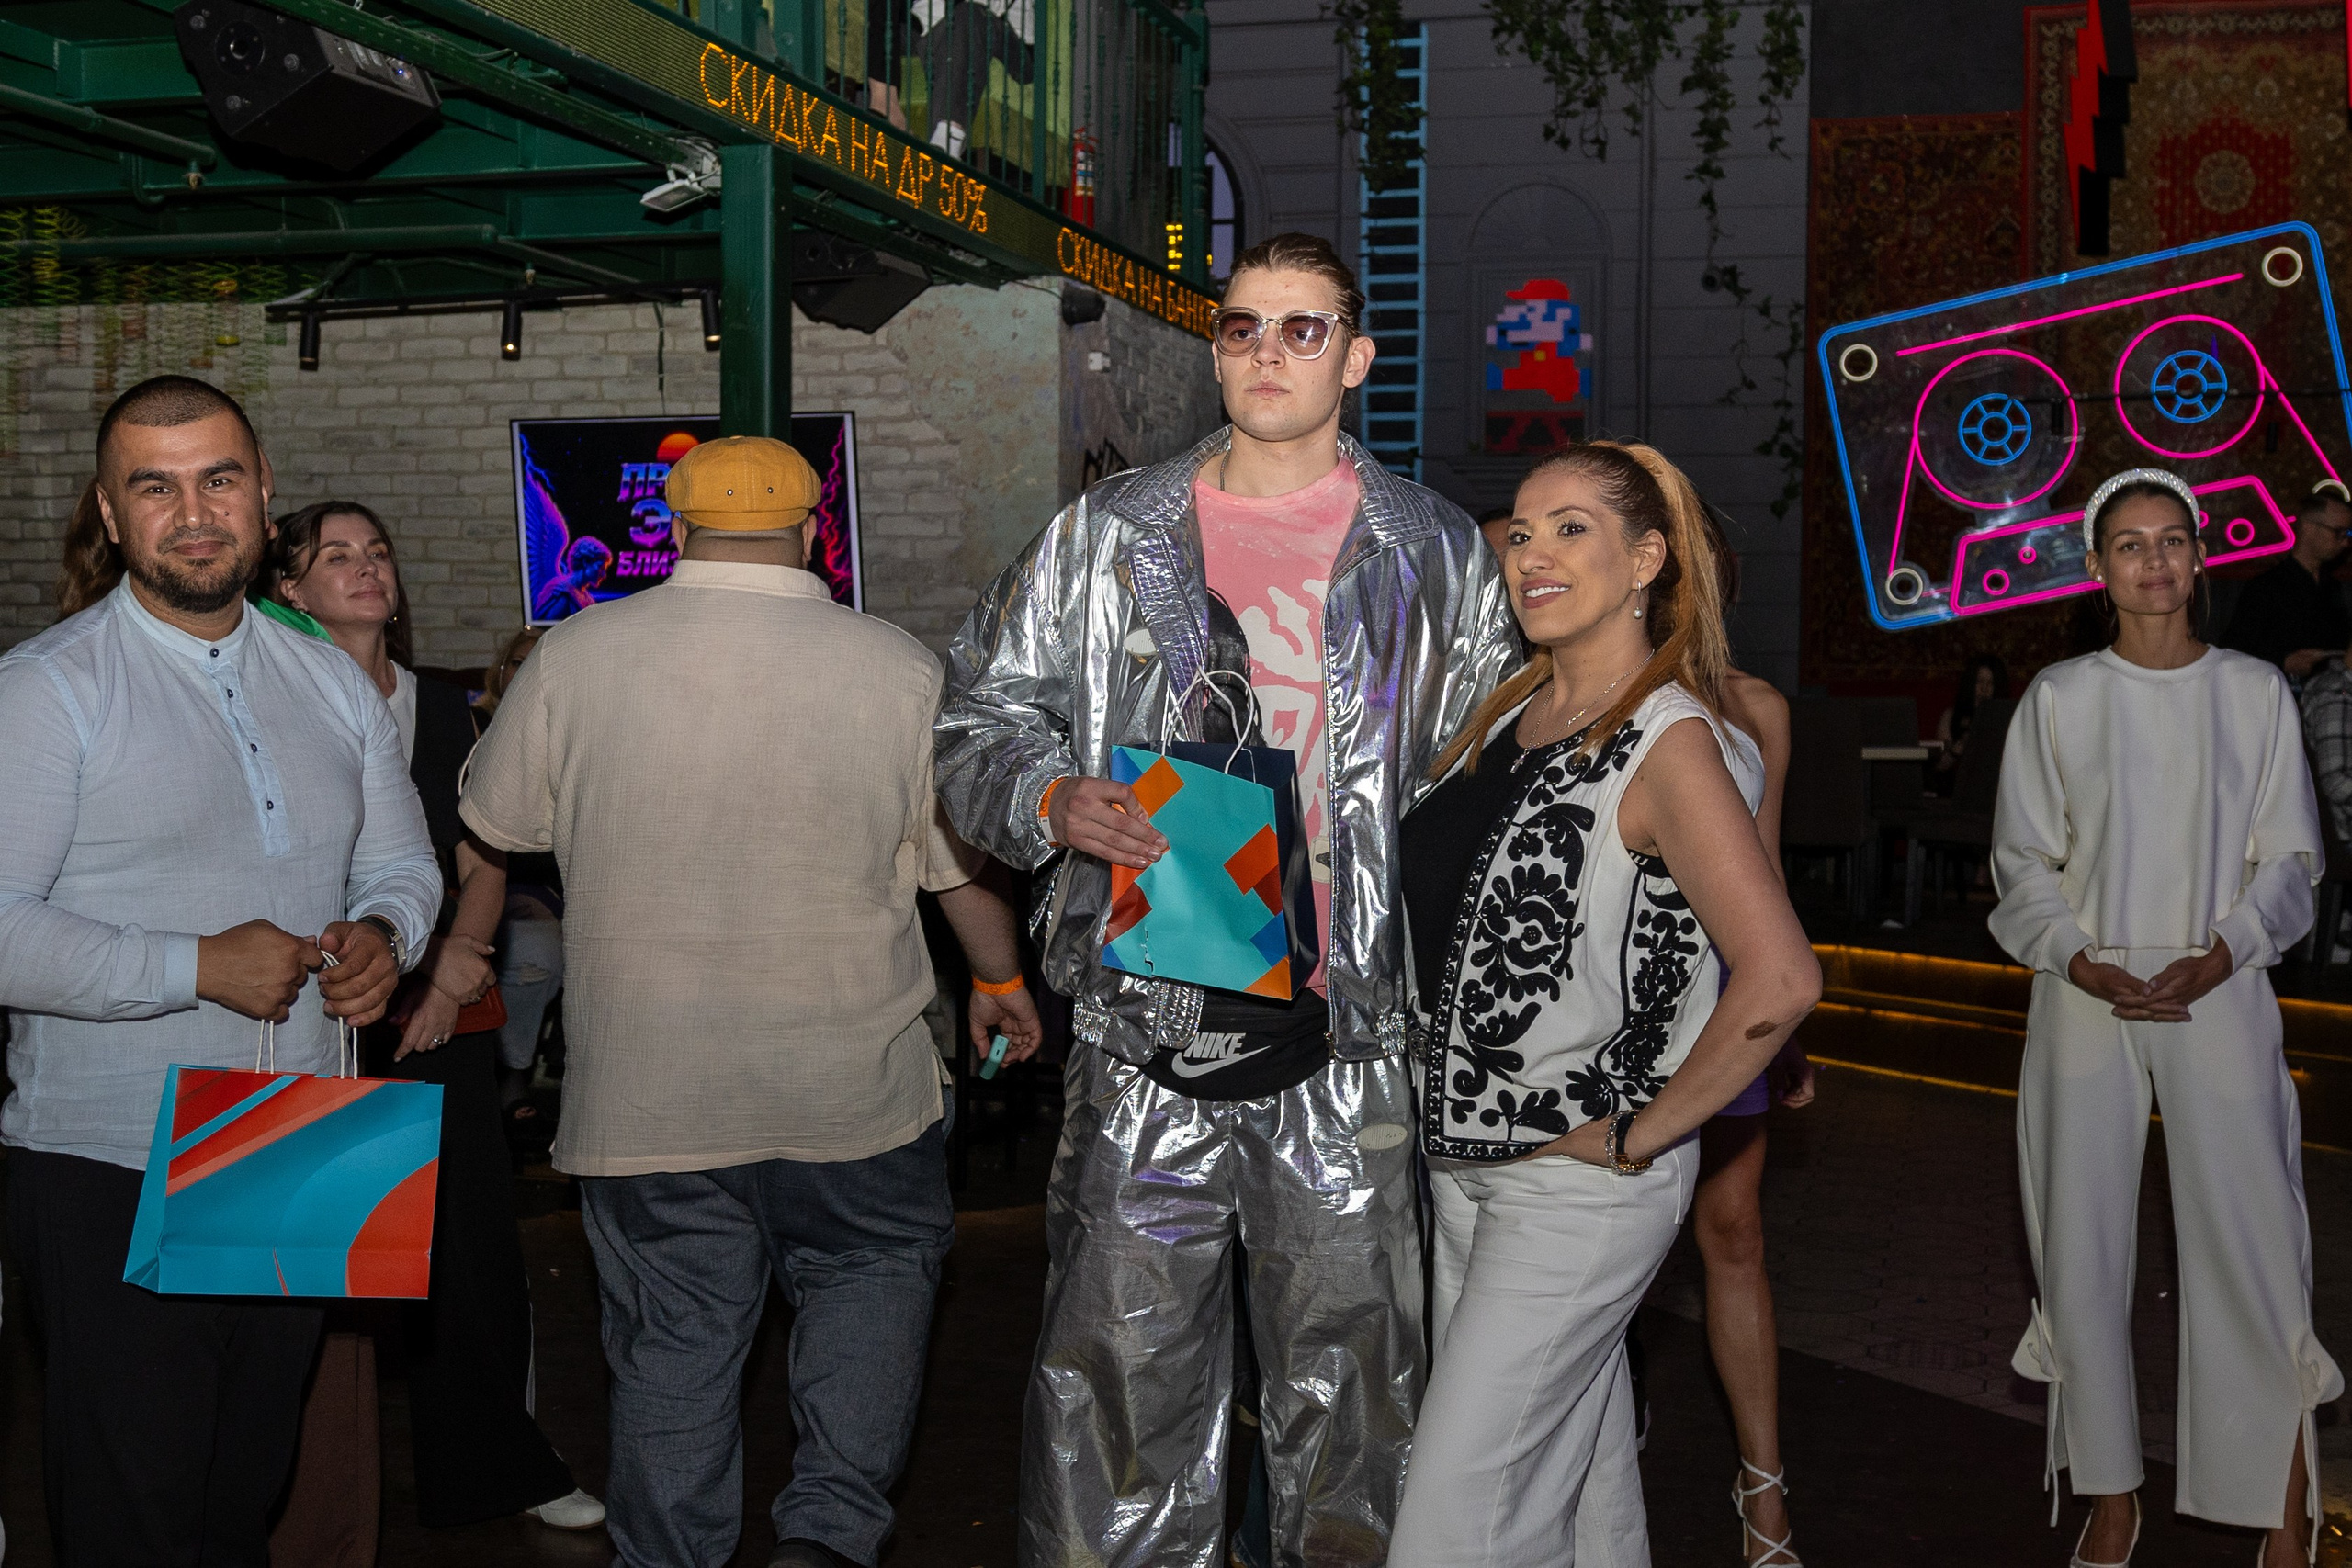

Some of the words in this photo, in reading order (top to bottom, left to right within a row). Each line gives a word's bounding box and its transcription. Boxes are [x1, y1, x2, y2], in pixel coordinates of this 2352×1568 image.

[699, 42, 842, 165] СКИДКА
[851, 117, 892, 189] НА
[895, 145, 934, 209] ДР
[938, 164, 988, 233] 50%
[1057, 226, 1137, 304] СКИДКА
[1138, 265, 1164, 317] НА
[1166, 279, 1220, 341] БАНКЕ
[616, 462, 672, 503] ПР
[628, 497, 673, 549] Э
[616, 550, 680, 577] БЛИЗ
[1183, 1032, 1247, 1059] NIKE
